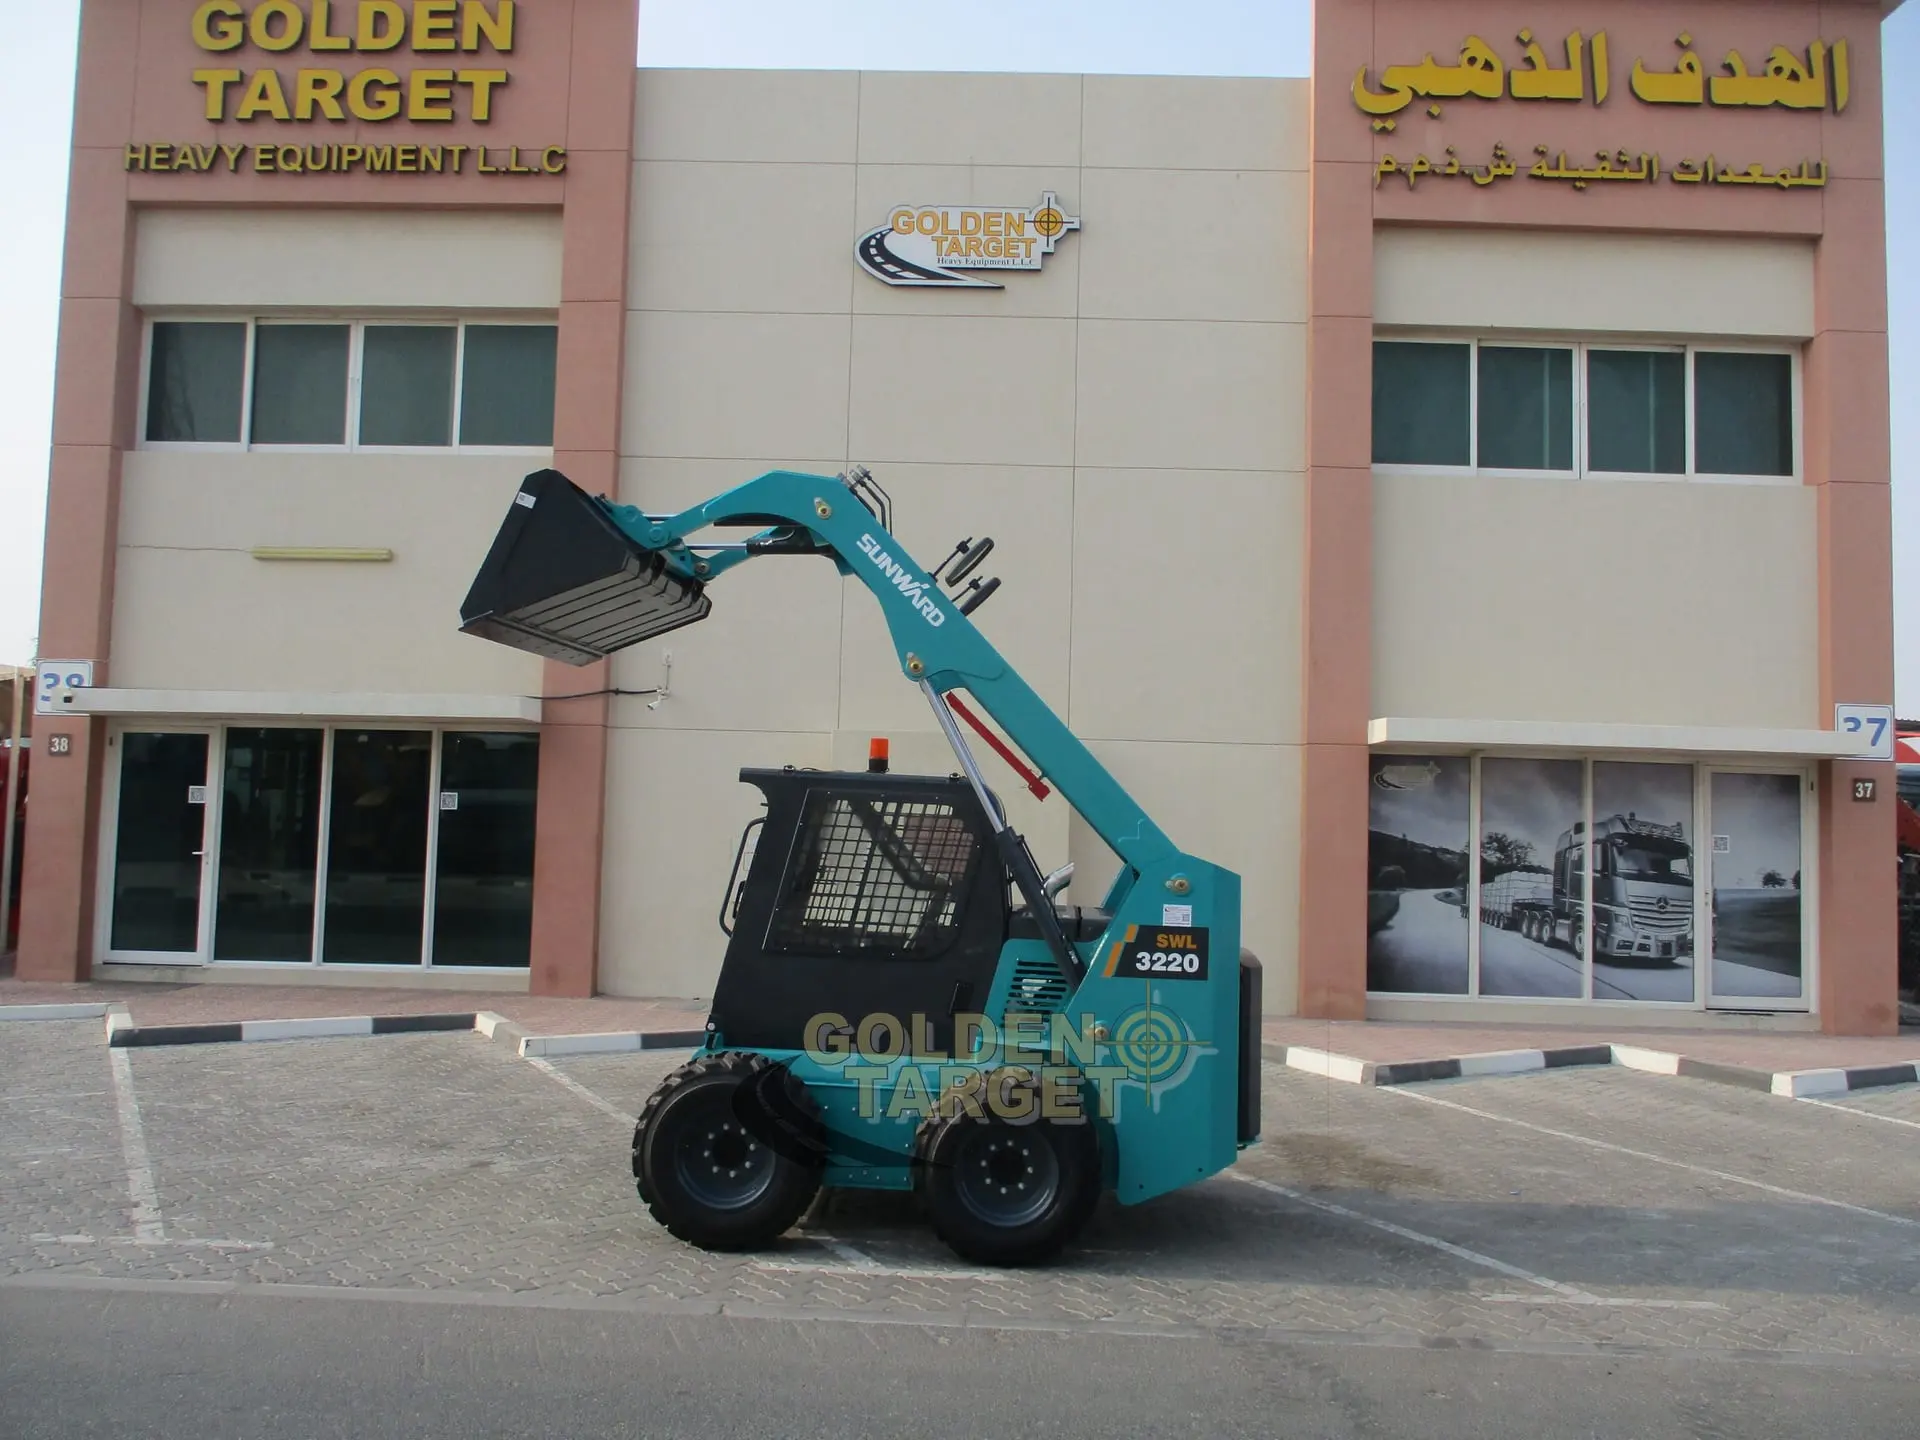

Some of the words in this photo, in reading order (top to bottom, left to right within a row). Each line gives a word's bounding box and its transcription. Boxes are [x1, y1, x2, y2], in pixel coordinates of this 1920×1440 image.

[191, 0, 515, 51] GOLDEN
[1351, 28, 1608, 132] الذهبي
[1629, 31, 1849, 113] الهدف
[192, 69, 508, 122] TARGET
[124, 144, 244, 174] HEAVY
[253, 145, 466, 173] EQUIPMENT
[477, 145, 567, 174] L.L.C
[1527, 145, 1659, 190] الثقيلة
[1672, 153, 1827, 188] للمعدات
[892, 210, 1025, 236] GOLDEN
[931, 236, 1037, 258] TARGET
[937, 257, 962, 266] Heavy
[965, 258, 1009, 267] Equipment
[856, 533, 945, 627] SUNWARD
[51, 737, 69, 752] 38
[1855, 782, 1873, 798] 37
[1156, 934, 1197, 949] SWL
[1135, 952, 1199, 973] 3220
